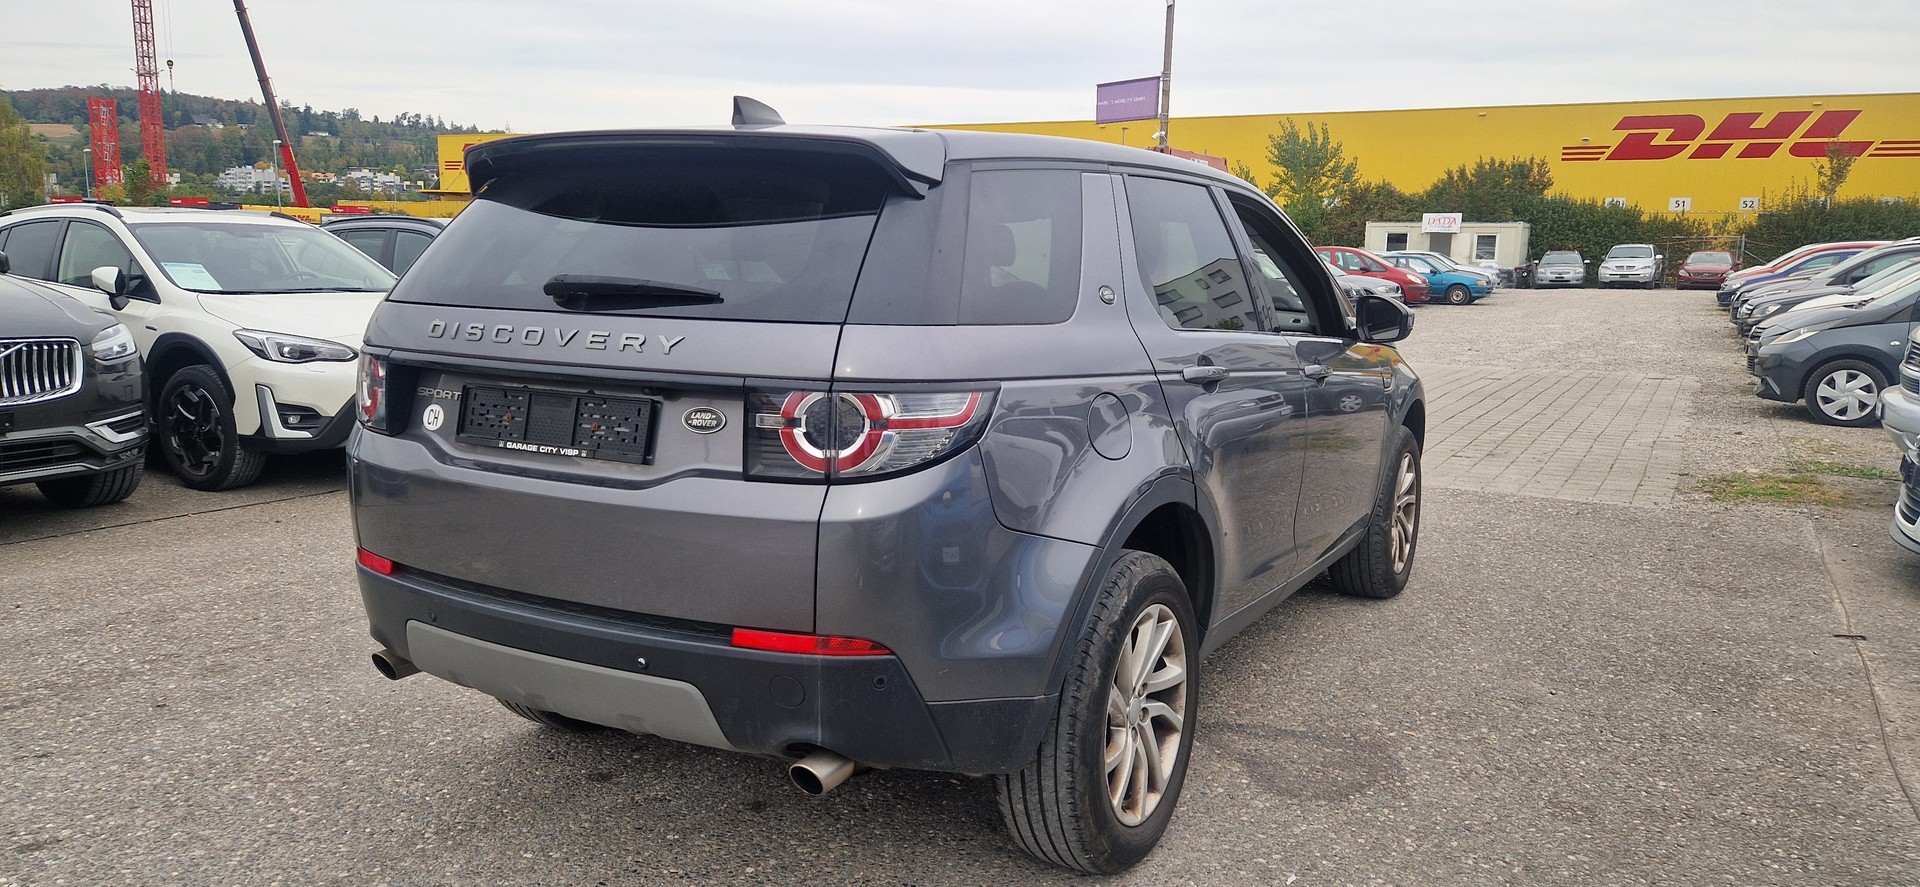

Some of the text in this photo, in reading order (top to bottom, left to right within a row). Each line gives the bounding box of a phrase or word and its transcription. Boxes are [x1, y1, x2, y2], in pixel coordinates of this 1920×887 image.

[1605, 109, 1876, 160] DHL
[1674, 200, 1687, 208] 51
[1742, 200, 1755, 208] 52
[427, 318, 686, 356] DISCOVERY
[417, 386, 462, 401] SPORT
[427, 408, 441, 427] CH
[506, 441, 579, 456] GARAGE CITY VISP
